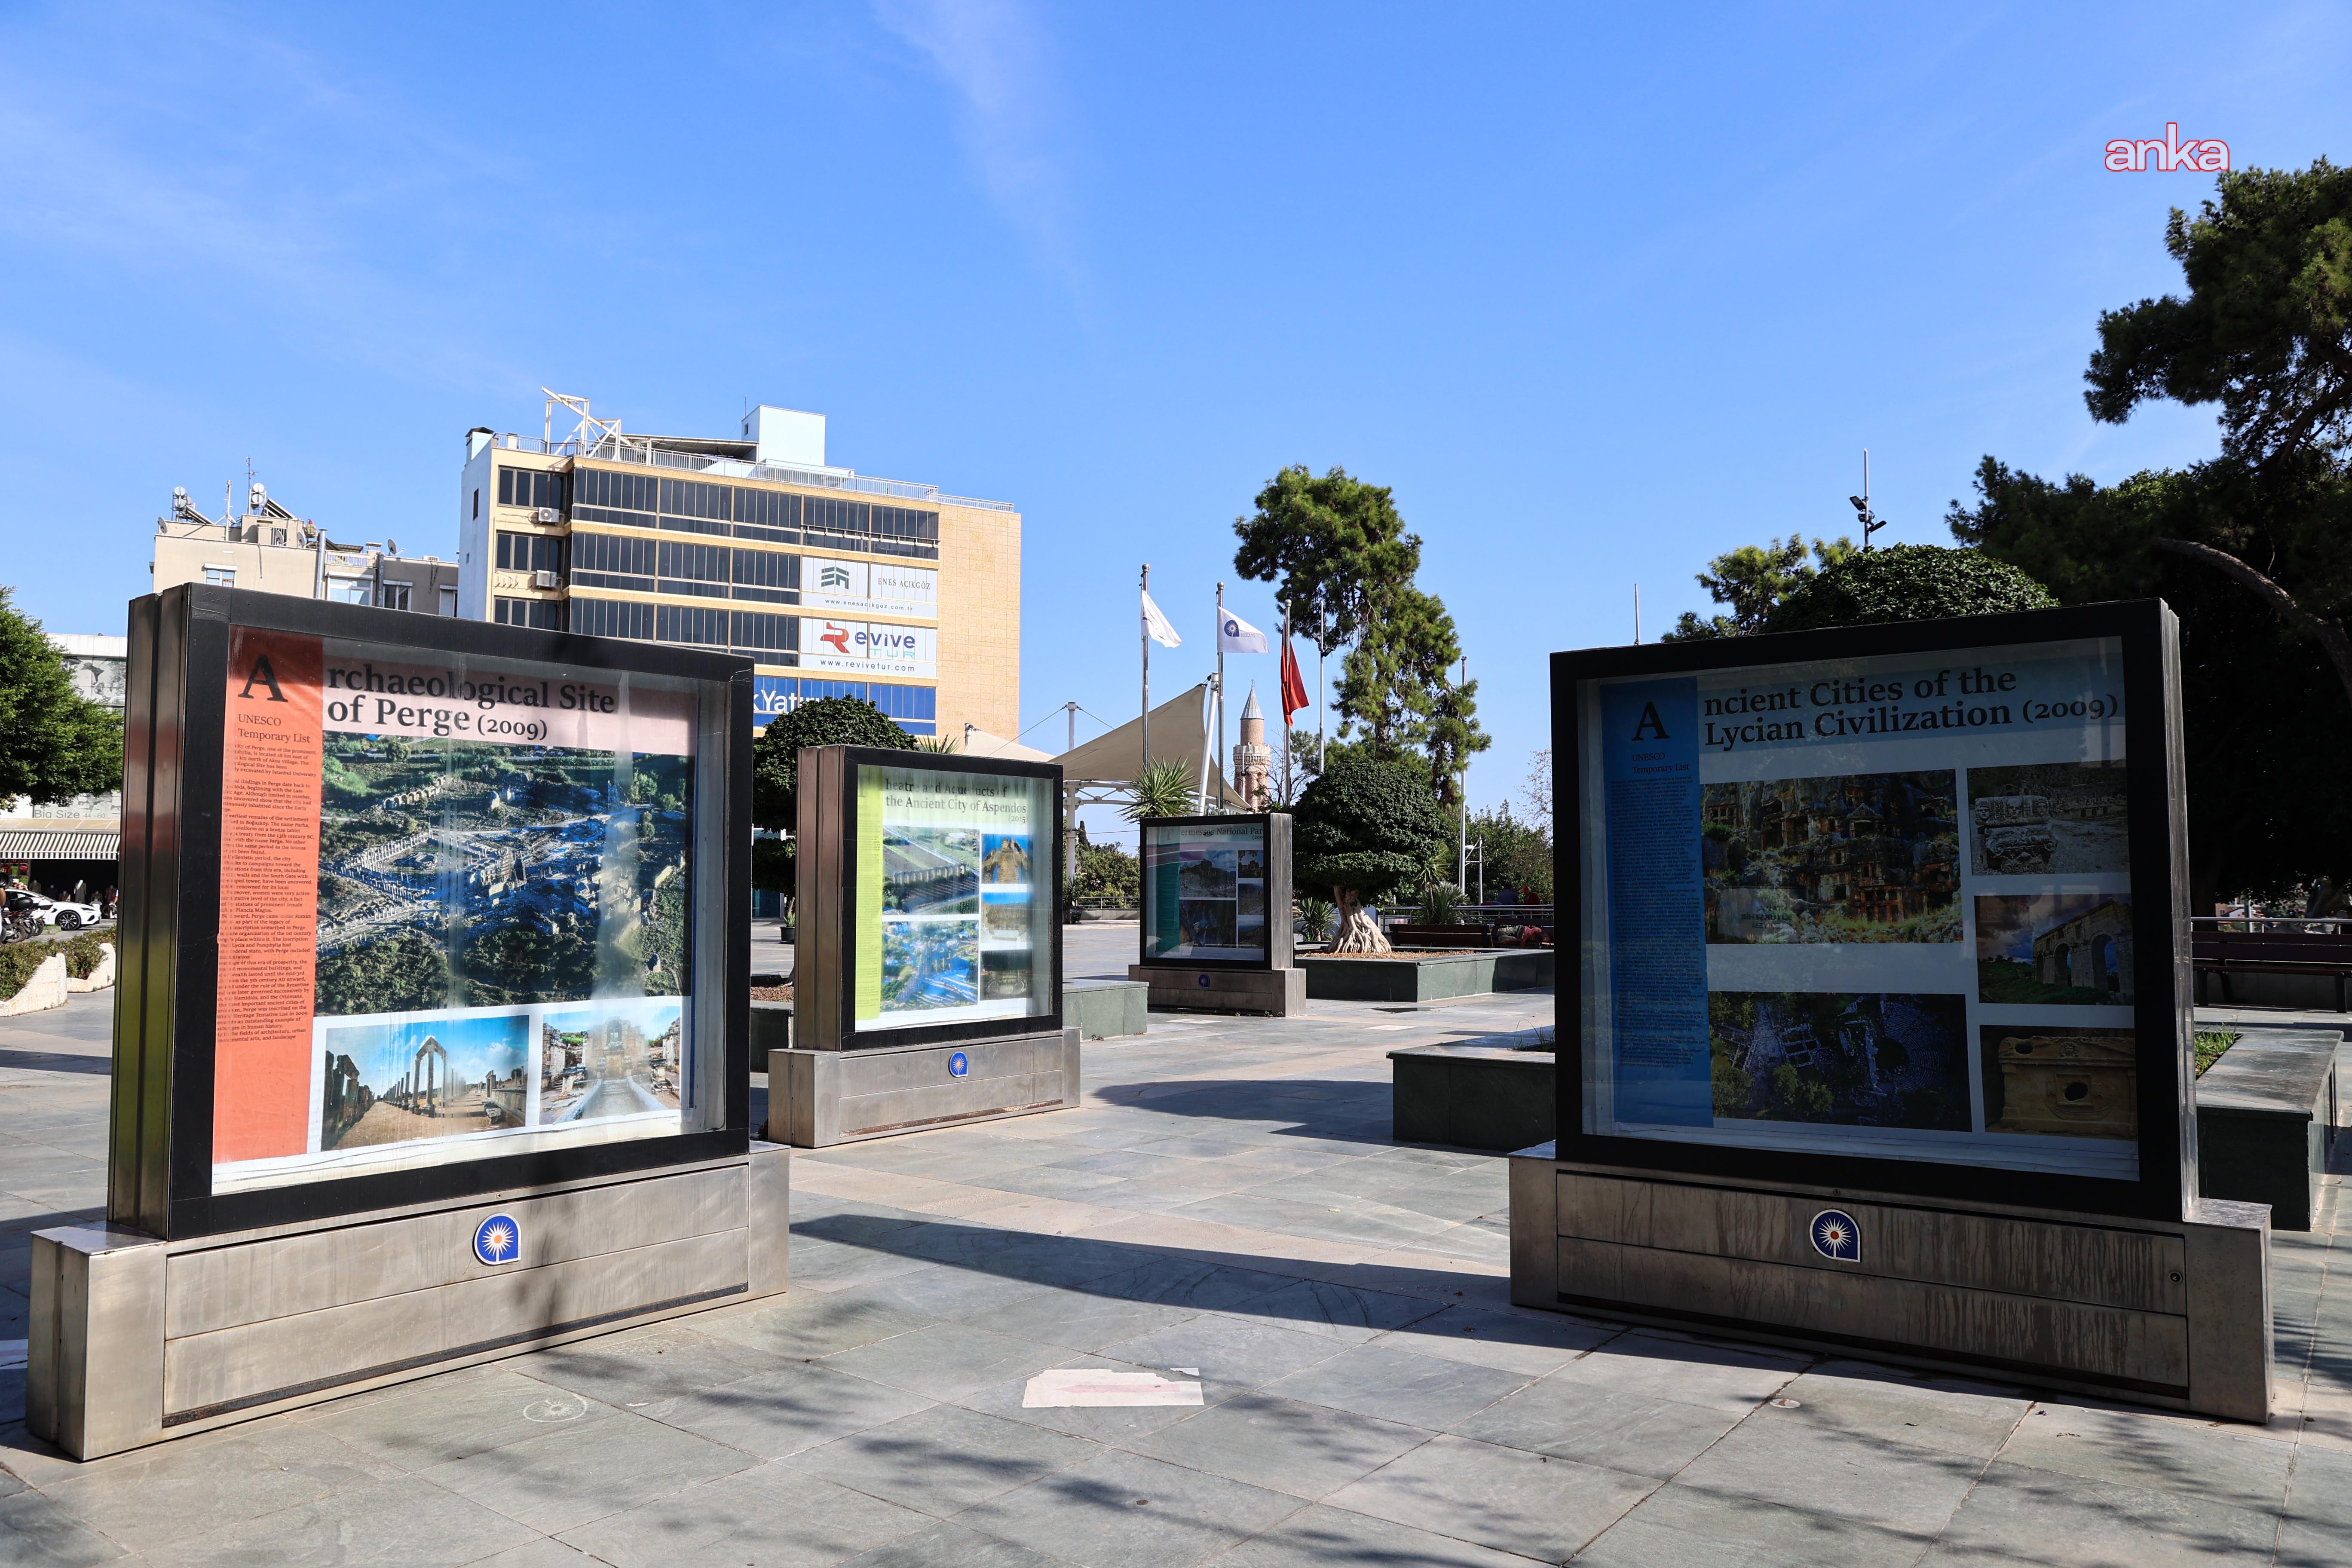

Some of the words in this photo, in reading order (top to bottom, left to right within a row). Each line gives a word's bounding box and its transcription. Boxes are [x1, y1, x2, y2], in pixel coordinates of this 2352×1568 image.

[878, 578, 897, 586] ENES
[899, 580, 931, 589] AÇIKGÖZ
[870, 648, 914, 658] TUR
[820, 658, 915, 672] www.revivetur.com
[238, 654, 288, 702] A
[327, 663, 550, 710] rchaeological
[559, 684, 614, 714] Site
[1704, 687, 1801, 717] ncient
[1810, 677, 1903, 707] Cities
[1914, 669, 1950, 698] of
[1957, 667, 2017, 695] the
[239, 714, 282, 726] UNESCO
[328, 694, 366, 723] of
[374, 698, 470, 737] Perge
[477, 714, 547, 740] (2009)
[1631, 701, 1670, 741] A
[1705, 717, 1805, 751] Lycian
[1814, 700, 2013, 737] Civilization
[2023, 693, 2118, 723] (2009)
[238, 728, 291, 743] Temporary
[294, 734, 310, 743] List
[1632, 752, 1666, 762] UNESCO
[1632, 764, 1673, 775] Temporary
[1675, 763, 1689, 771] List
[886, 795, 902, 807] the
[905, 796, 945, 809] Ancient
[948, 798, 966, 813] City
[970, 799, 981, 812] of
[982, 802, 1026, 815] Aspendos
[56, 810, 80, 818] Size
[1008, 815, 1028, 824] (2015)
[1217, 827, 1248, 835] National
